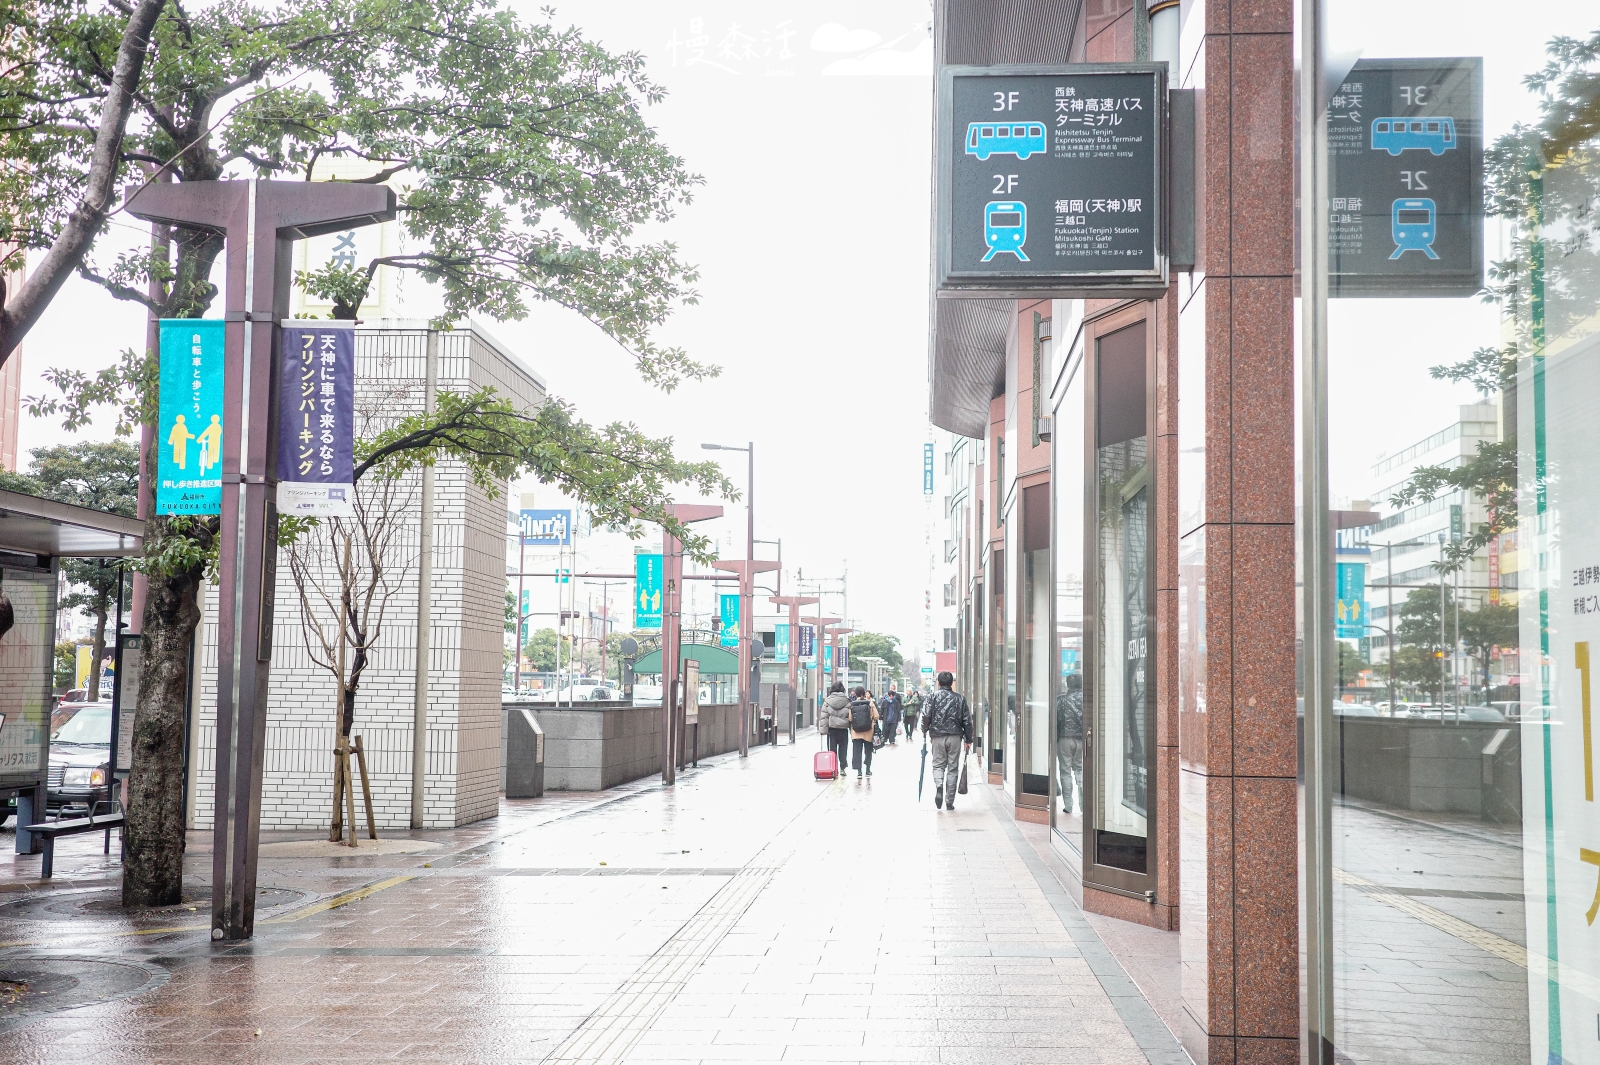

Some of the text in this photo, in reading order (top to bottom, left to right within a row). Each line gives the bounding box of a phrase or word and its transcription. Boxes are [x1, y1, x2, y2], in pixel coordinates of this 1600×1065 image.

[1054, 86, 1076, 97] 西鉄
[992, 91, 1020, 112] 3F
[1054, 97, 1143, 112] 天神高速バス
[1055, 112, 1123, 127] ターミナル
[1054, 128, 1114, 137] Nishitetsu Tenjin
[1054, 136, 1095, 144] Expressway
[992, 174, 1019, 194] 2F
[1054, 216, 1086, 226] 三越口
[190, 334, 203, 419] 自転車と歩こう。
[298, 334, 316, 476] フリンジパーキング
[318, 334, 336, 476] 天神に車で来るなら
